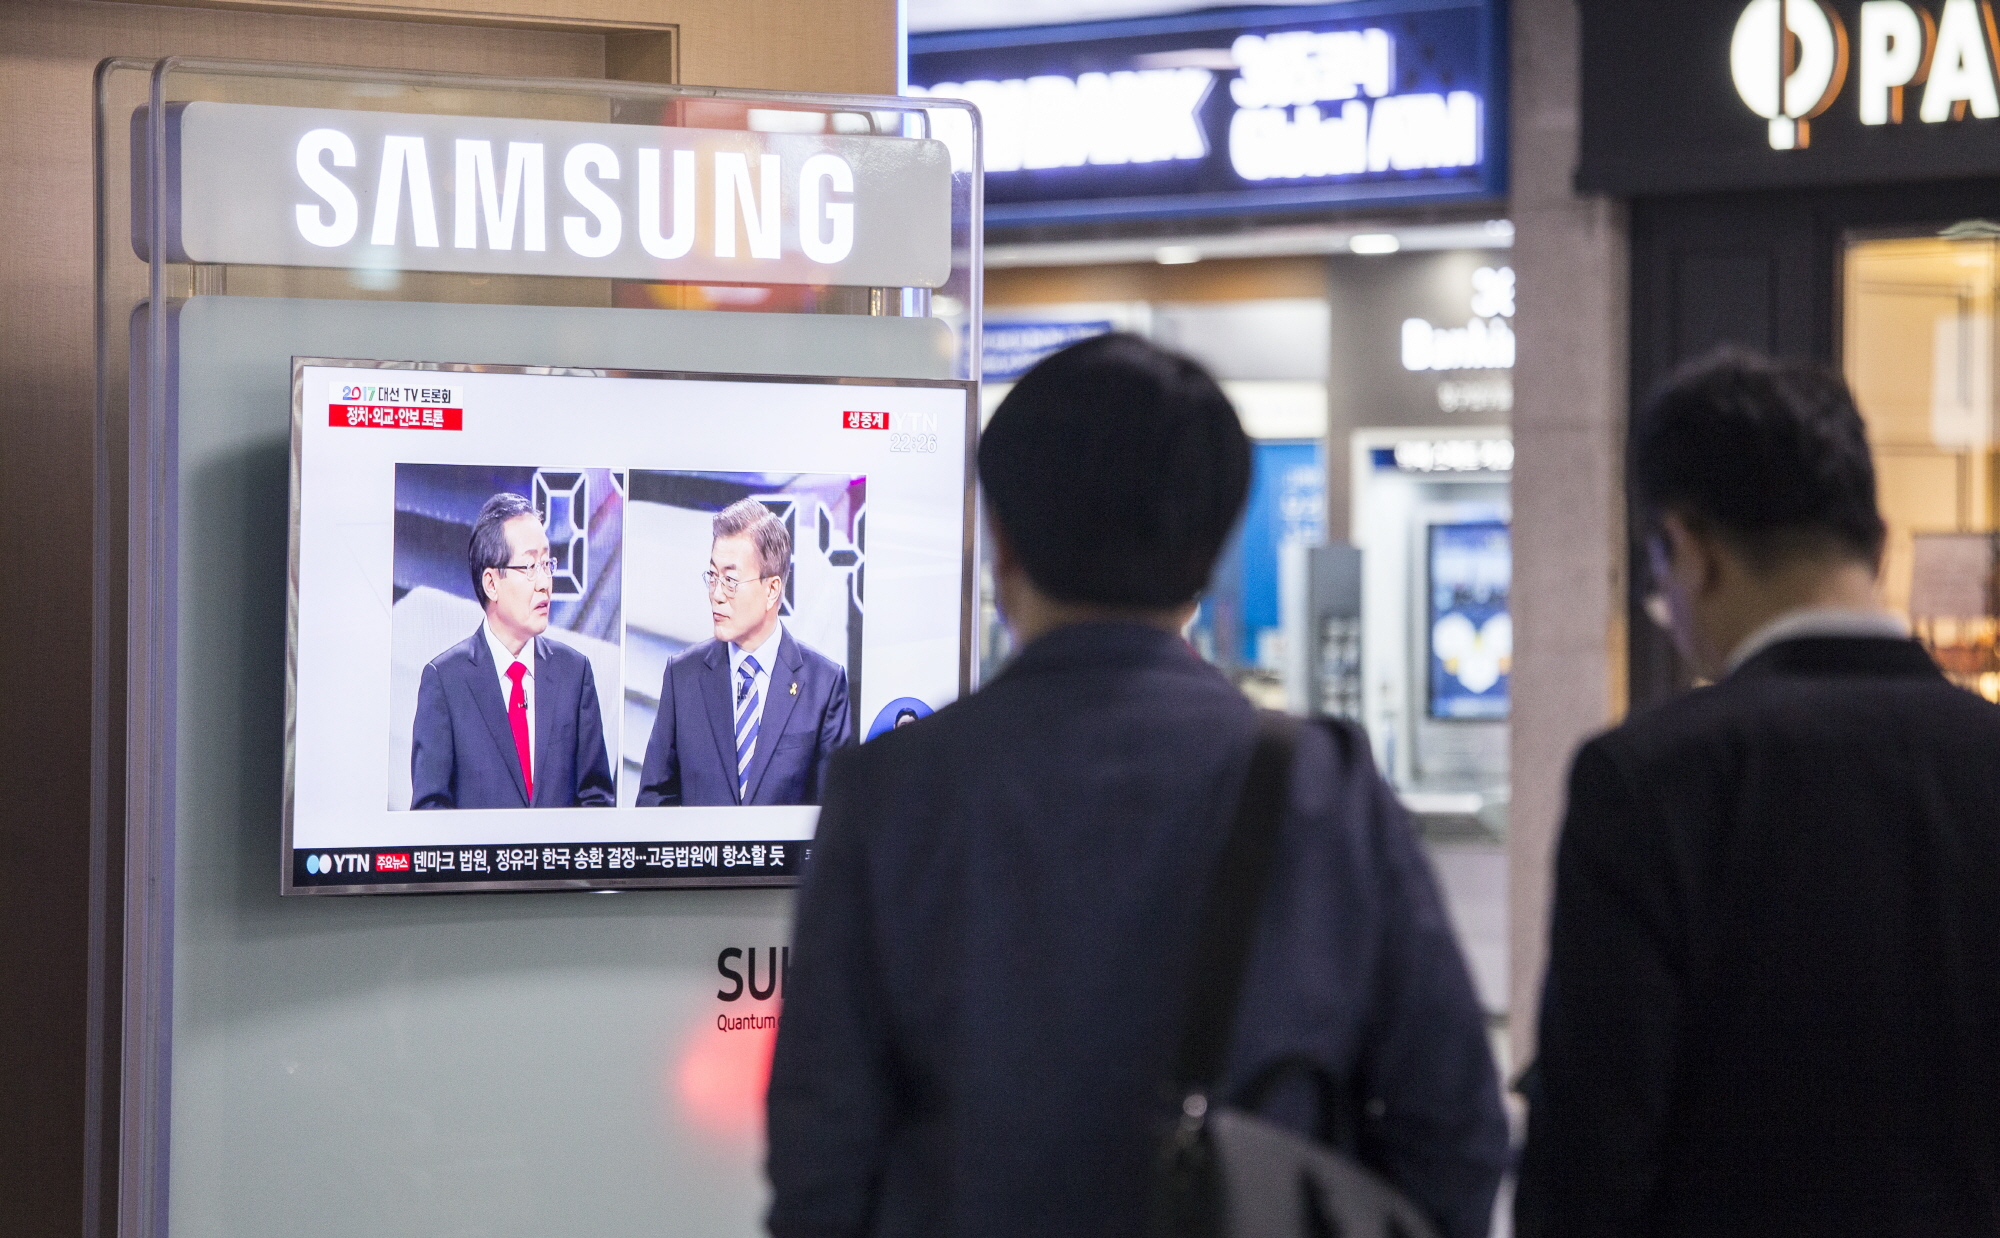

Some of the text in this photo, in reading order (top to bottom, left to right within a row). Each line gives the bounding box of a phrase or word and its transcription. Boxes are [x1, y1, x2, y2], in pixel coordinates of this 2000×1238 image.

[295, 128, 855, 264] SAMSUNG
[342, 385, 451, 404] 2017 대선 TV 토론회
[421, 409, 444, 428] 토론
[848, 411, 884, 429] 생중계
[893, 412, 938, 431] YTN
[890, 433, 937, 453] 22:26
[333, 853, 370, 874] YTN
[376, 855, 408, 870] 주요뉴스
[413, 851, 455, 873] 덴마크
[459, 849, 491, 874] 법원,
[496, 848, 538, 871] 정유라
[542, 847, 571, 870] 한국
[573, 847, 604, 870] 송환
[722, 845, 766, 867] 항소할
[769, 845, 785, 867] 듯
[717, 1013, 776, 1033] Quantum
